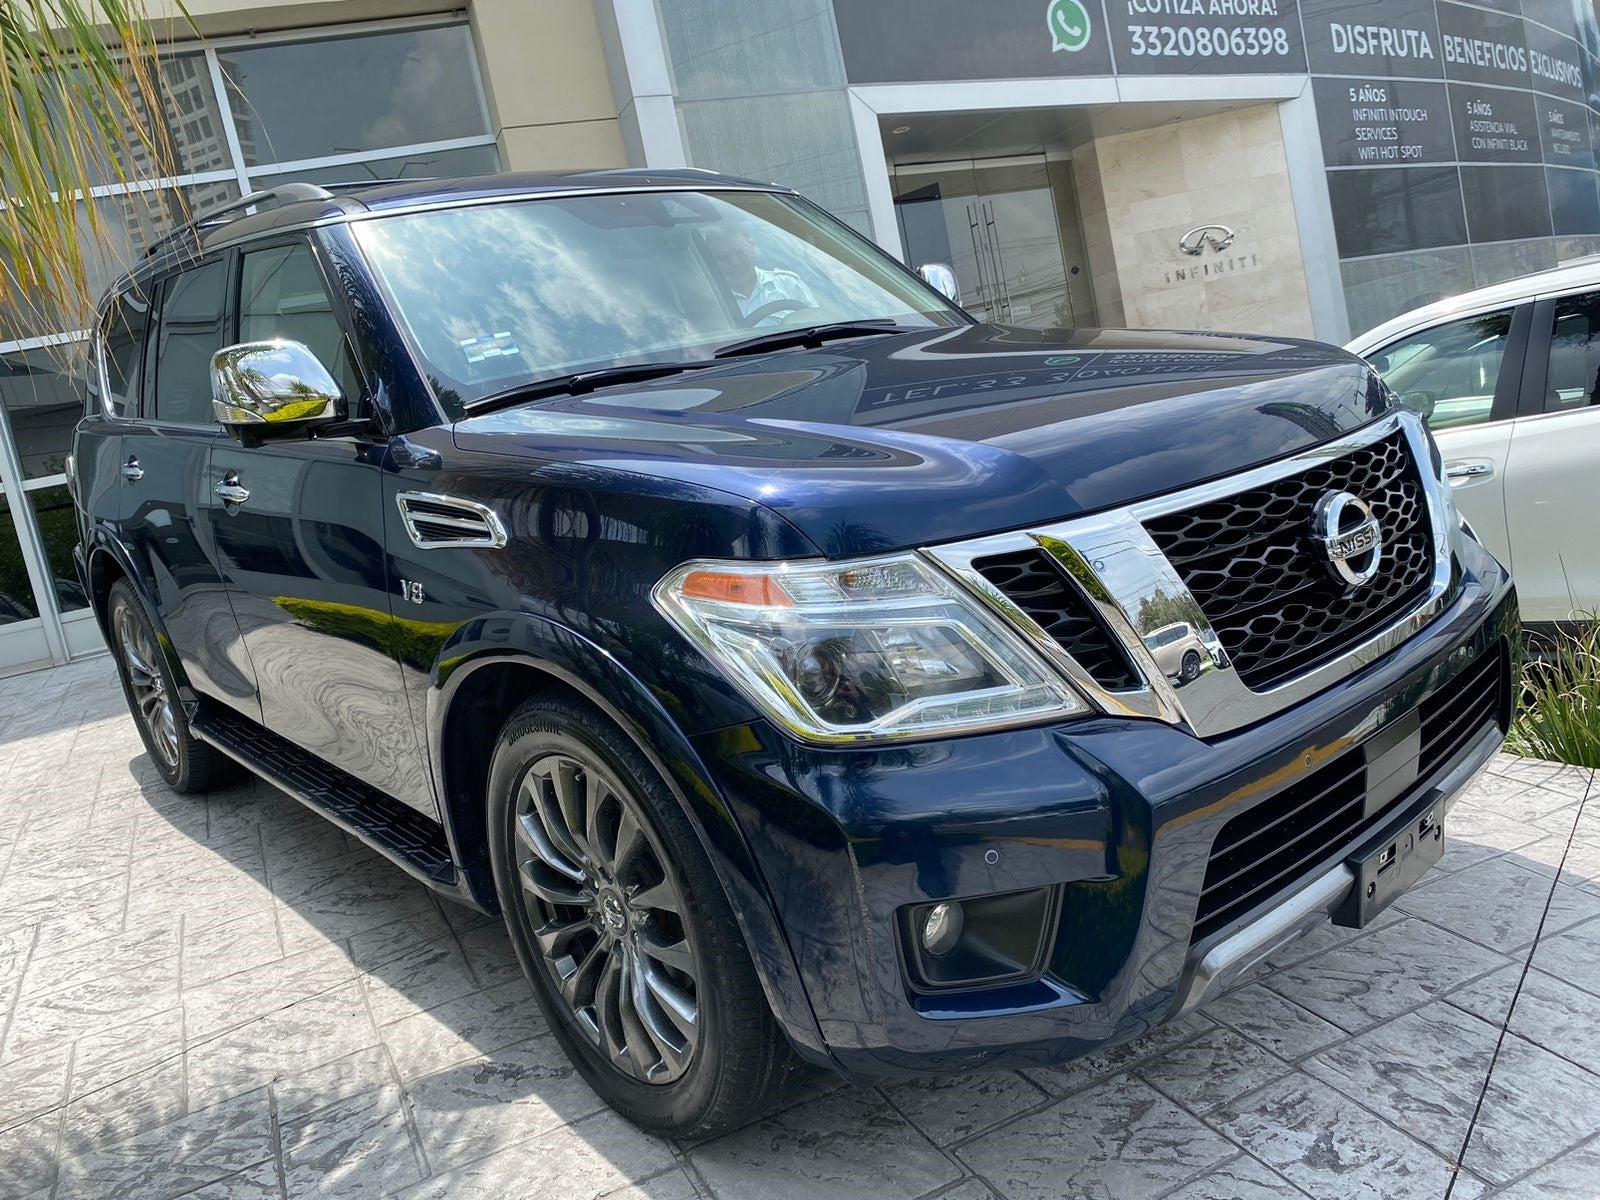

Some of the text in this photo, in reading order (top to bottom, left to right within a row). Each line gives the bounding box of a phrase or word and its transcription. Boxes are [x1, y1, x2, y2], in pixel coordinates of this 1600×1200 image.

[1209, 0, 1278, 16] AHORA!
[1128, 25, 1289, 56] 3320806398
[1330, 23, 1582, 88] DISFRUTA BENEFICIOS EXCLUSIVOS
[1349, 84, 1386, 102] 5 AÑOS
[1353, 108, 1428, 121] INFINITI INTOUCH
[1466, 99, 1492, 116] 5 AÑOS
[1355, 127, 1398, 140] SERVICES
[1472, 137, 1486, 149] CON
[1358, 145, 1423, 160] WIFI HOT SPOT
[1165, 254, 1257, 284] INFINITI
[400, 579, 424, 604] V8
